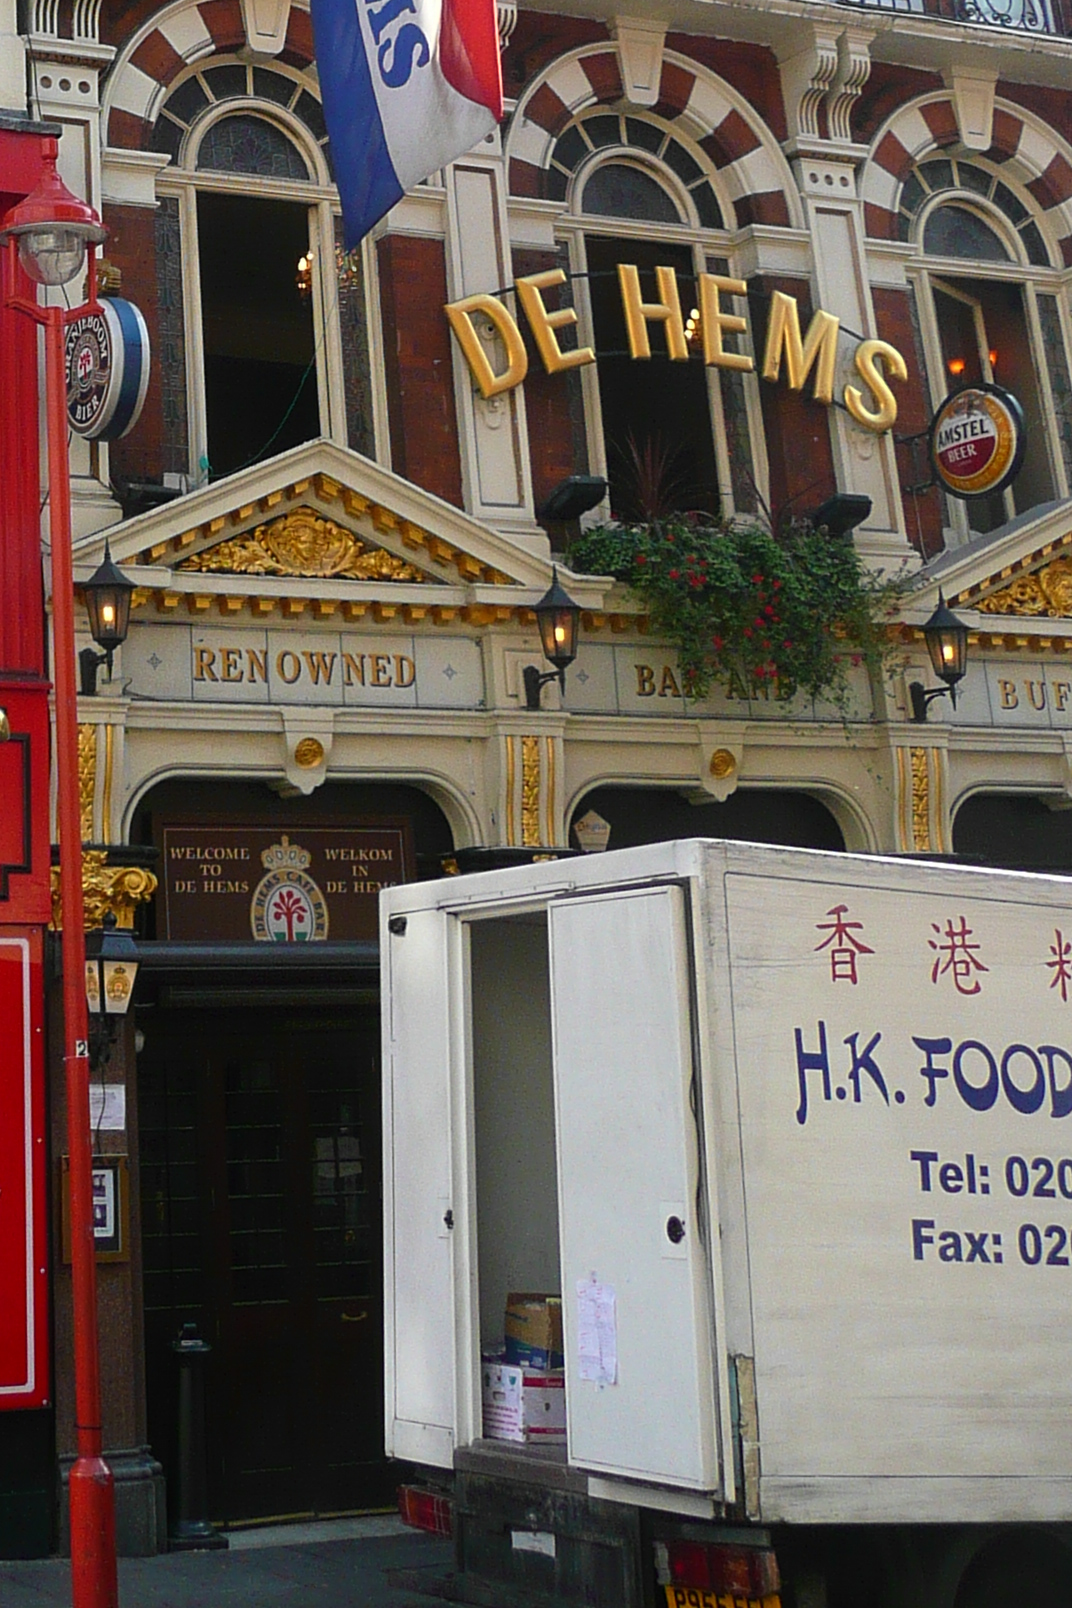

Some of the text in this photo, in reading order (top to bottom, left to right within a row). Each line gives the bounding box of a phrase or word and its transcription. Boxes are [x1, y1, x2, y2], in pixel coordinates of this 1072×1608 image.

[444, 263, 908, 432] DE HEMS
[75, 395, 99, 421] BIER
[938, 418, 989, 449] AMSTEL
[948, 443, 977, 464] BEER
[194, 646, 416, 688] RENOWNED
[170, 847, 250, 861] WELCOME
[324, 848, 393, 861] WELKOM
[200, 864, 222, 876] TO
[352, 864, 368, 877] IN
[175, 880, 250, 893] DE HEMS
[327, 880, 347, 893] DE
[77, 1042, 86, 1056] 2
[794, 1020, 1072, 1125] H.K. FOOD
[910, 1150, 990, 1195] Tel:
[911, 1218, 1072, 1266] Fax: 02
